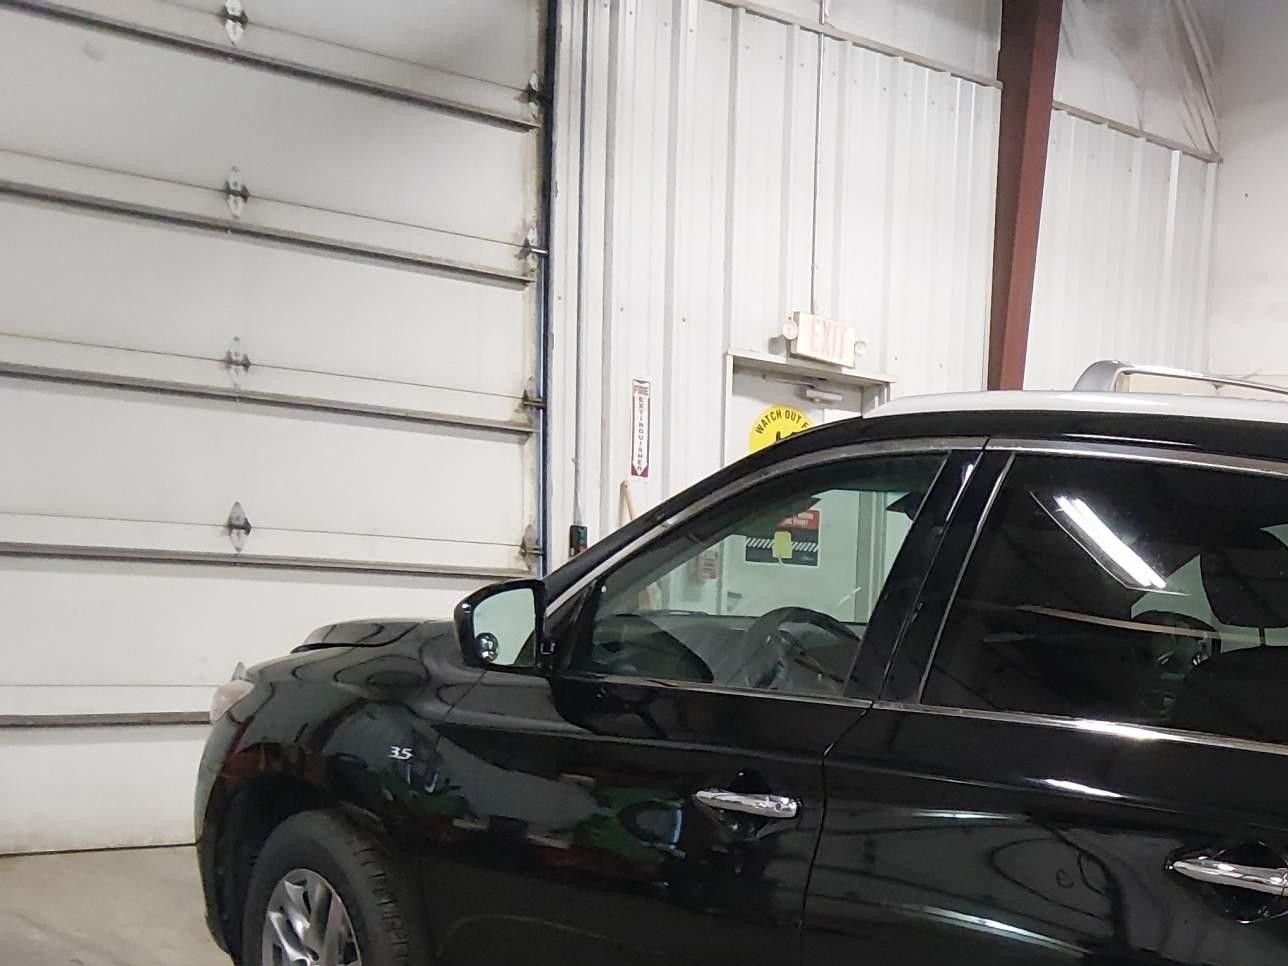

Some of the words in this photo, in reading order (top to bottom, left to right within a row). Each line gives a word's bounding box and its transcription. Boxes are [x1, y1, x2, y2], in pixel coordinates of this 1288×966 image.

[810, 317, 849, 359] EXIT
[633, 384, 649, 396] FIRE
[755, 408, 783, 434] WATCH
[784, 409, 803, 425] OUT
[388, 745, 414, 760] 35
